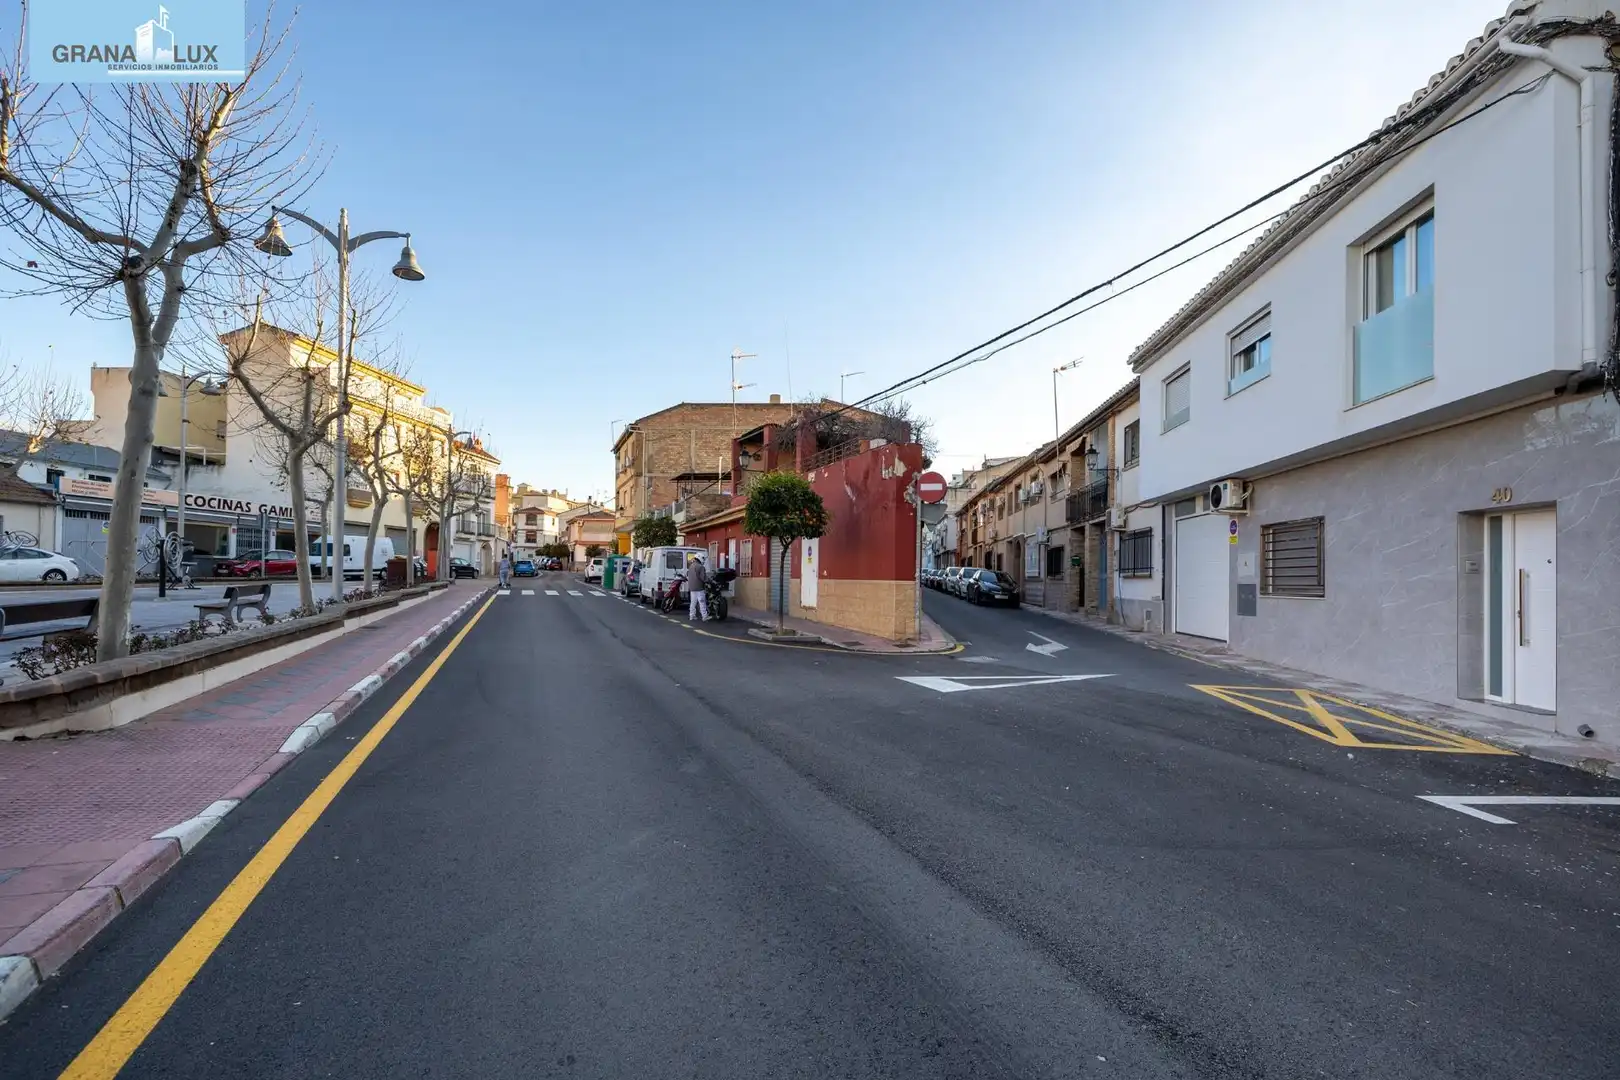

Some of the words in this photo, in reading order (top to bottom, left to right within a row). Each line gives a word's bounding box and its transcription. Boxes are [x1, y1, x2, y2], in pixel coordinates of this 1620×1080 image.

[1492, 486, 1513, 504] 40
[184, 494, 252, 513] COCINAS
[258, 503, 296, 519] GAMI
